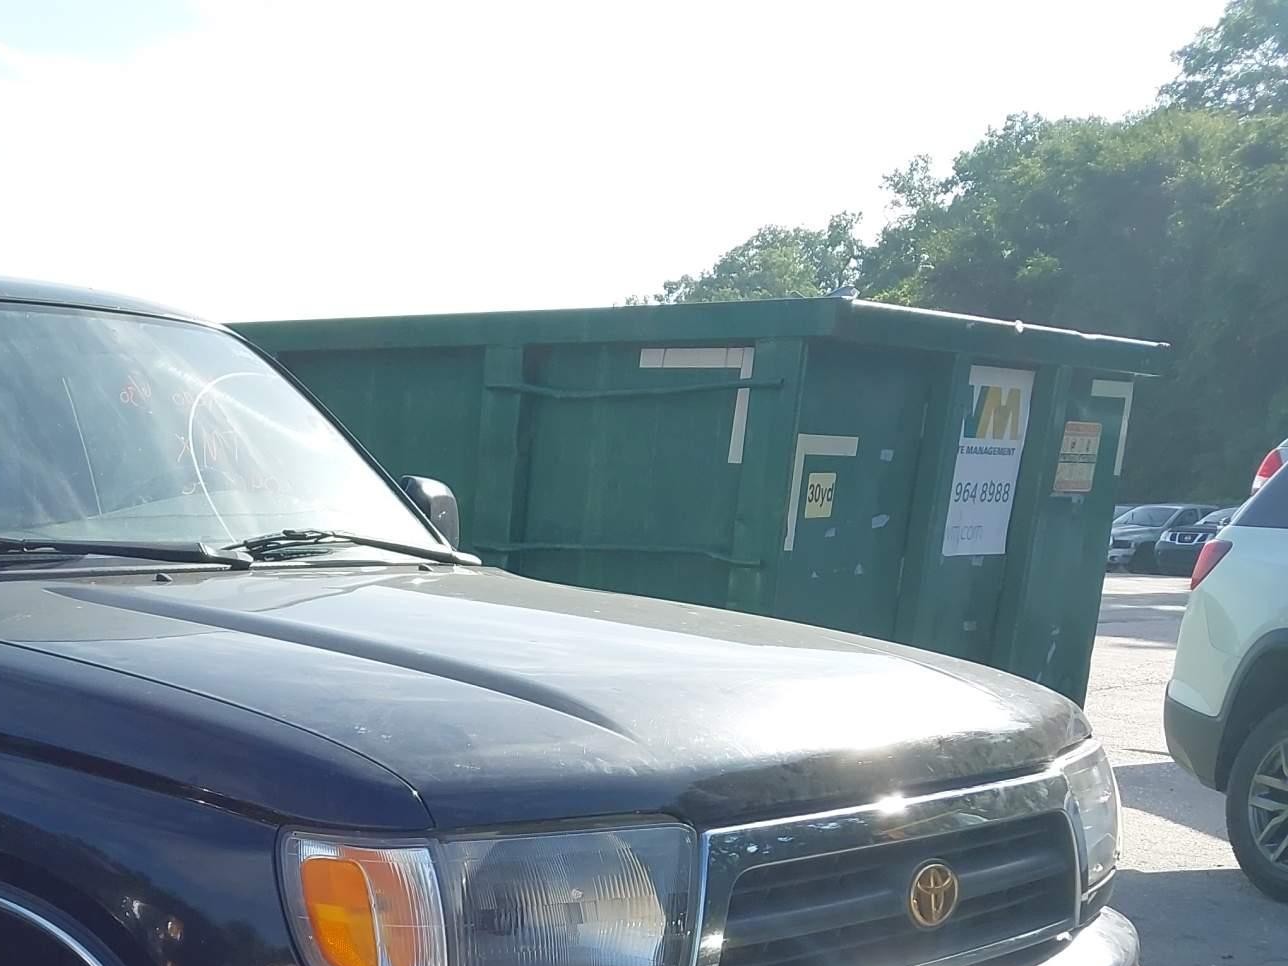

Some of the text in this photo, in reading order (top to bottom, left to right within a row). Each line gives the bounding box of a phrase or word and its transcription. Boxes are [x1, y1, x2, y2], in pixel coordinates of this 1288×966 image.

[966, 446, 1016, 456] MANAGEMENT
[808, 482, 835, 508] 30yd
[953, 480, 1011, 504] 964 8988
